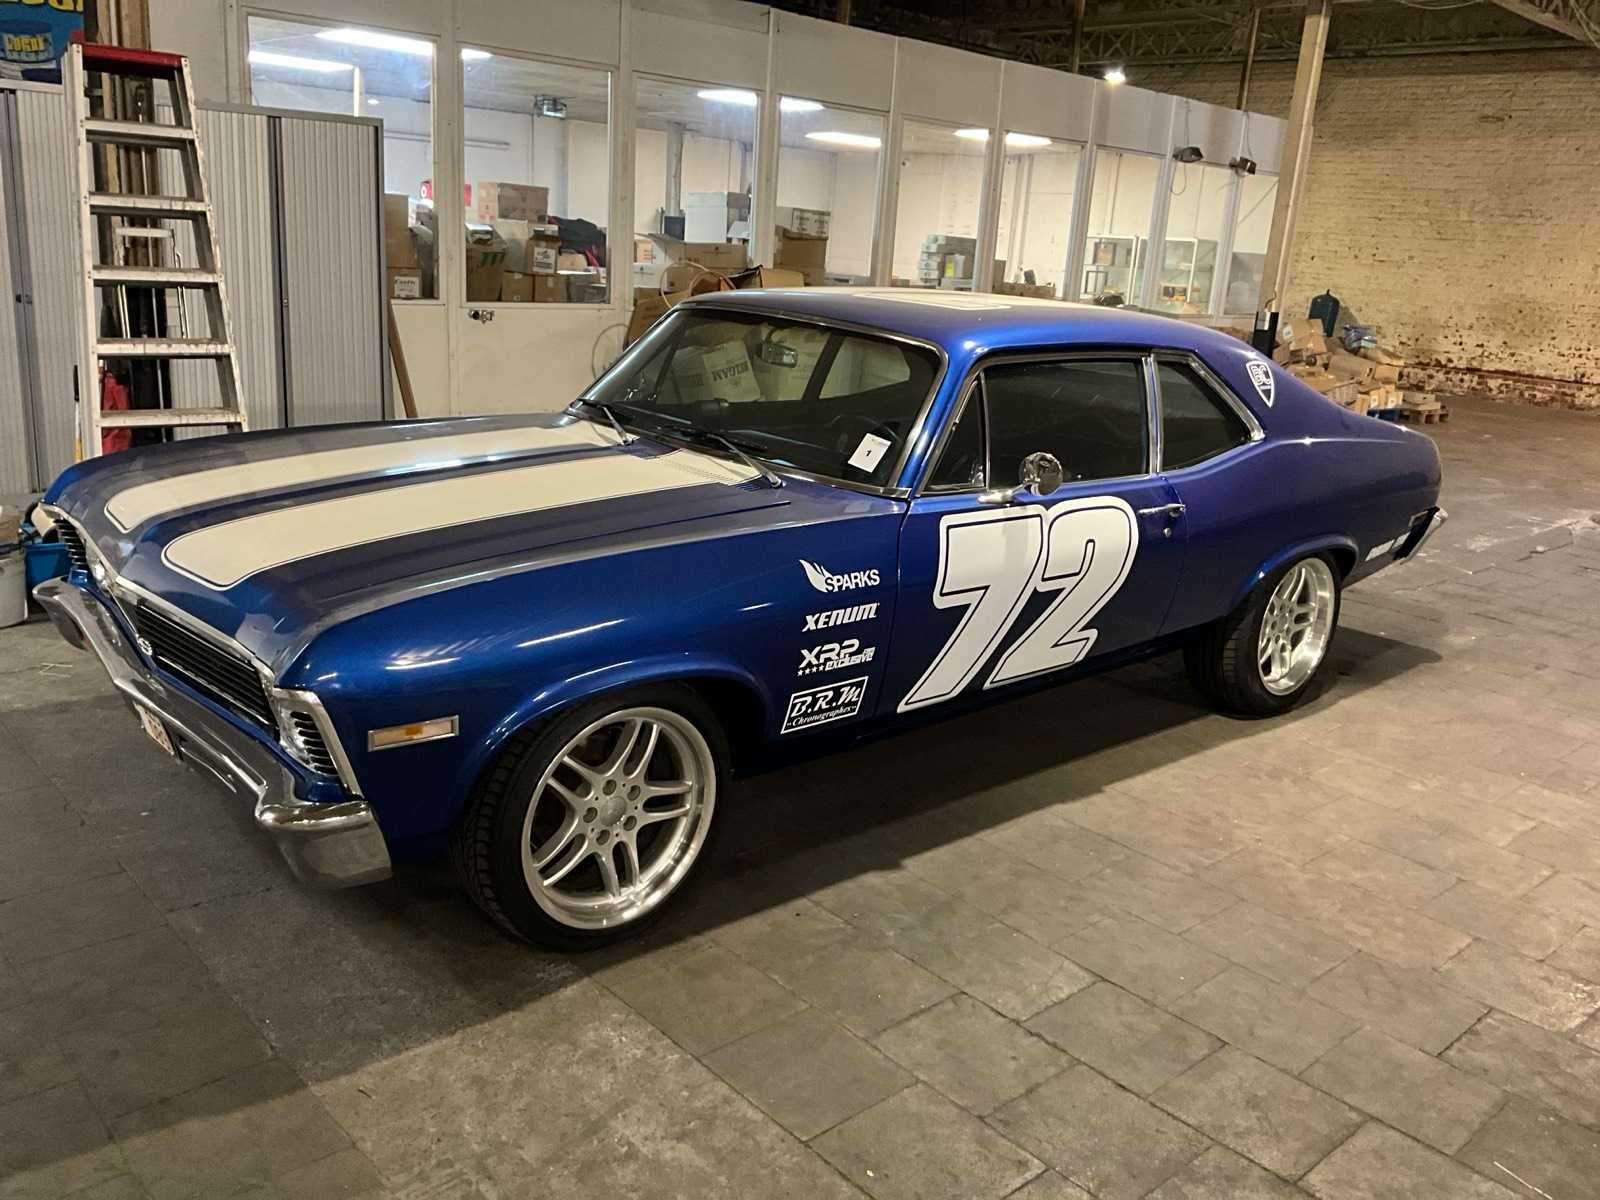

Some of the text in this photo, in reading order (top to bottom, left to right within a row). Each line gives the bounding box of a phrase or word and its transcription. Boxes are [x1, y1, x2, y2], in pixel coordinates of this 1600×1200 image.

[825, 569, 880, 592] SPARKS
[802, 603, 878, 632] XENUM
[896, 495, 1140, 714] 72
[799, 638, 860, 669] XRP
